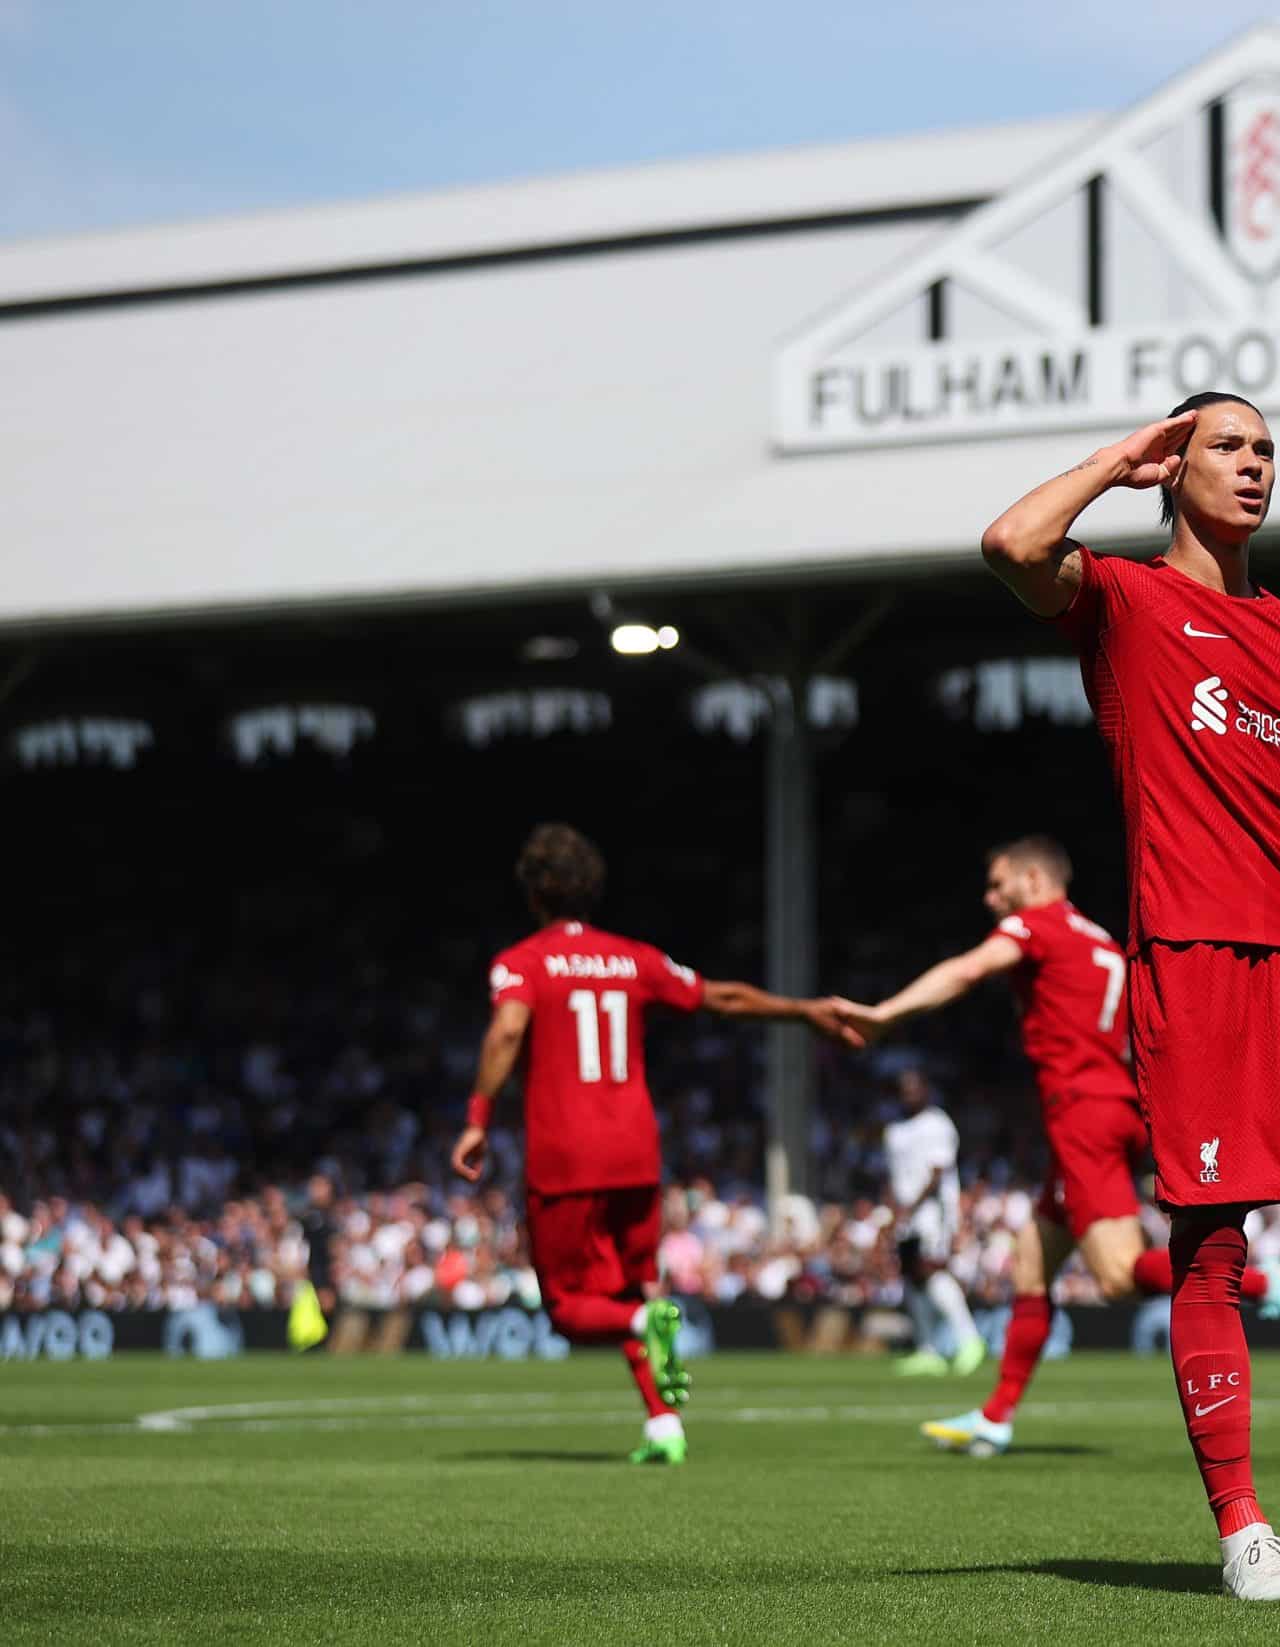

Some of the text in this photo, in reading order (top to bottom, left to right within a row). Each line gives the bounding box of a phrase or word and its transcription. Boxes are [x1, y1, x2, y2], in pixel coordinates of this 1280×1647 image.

[810, 348, 1090, 425] FULHAM
[1091, 946, 1126, 1033] 7
[568, 988, 628, 1083] 11
[1200, 1172, 1222, 1183] LFC
